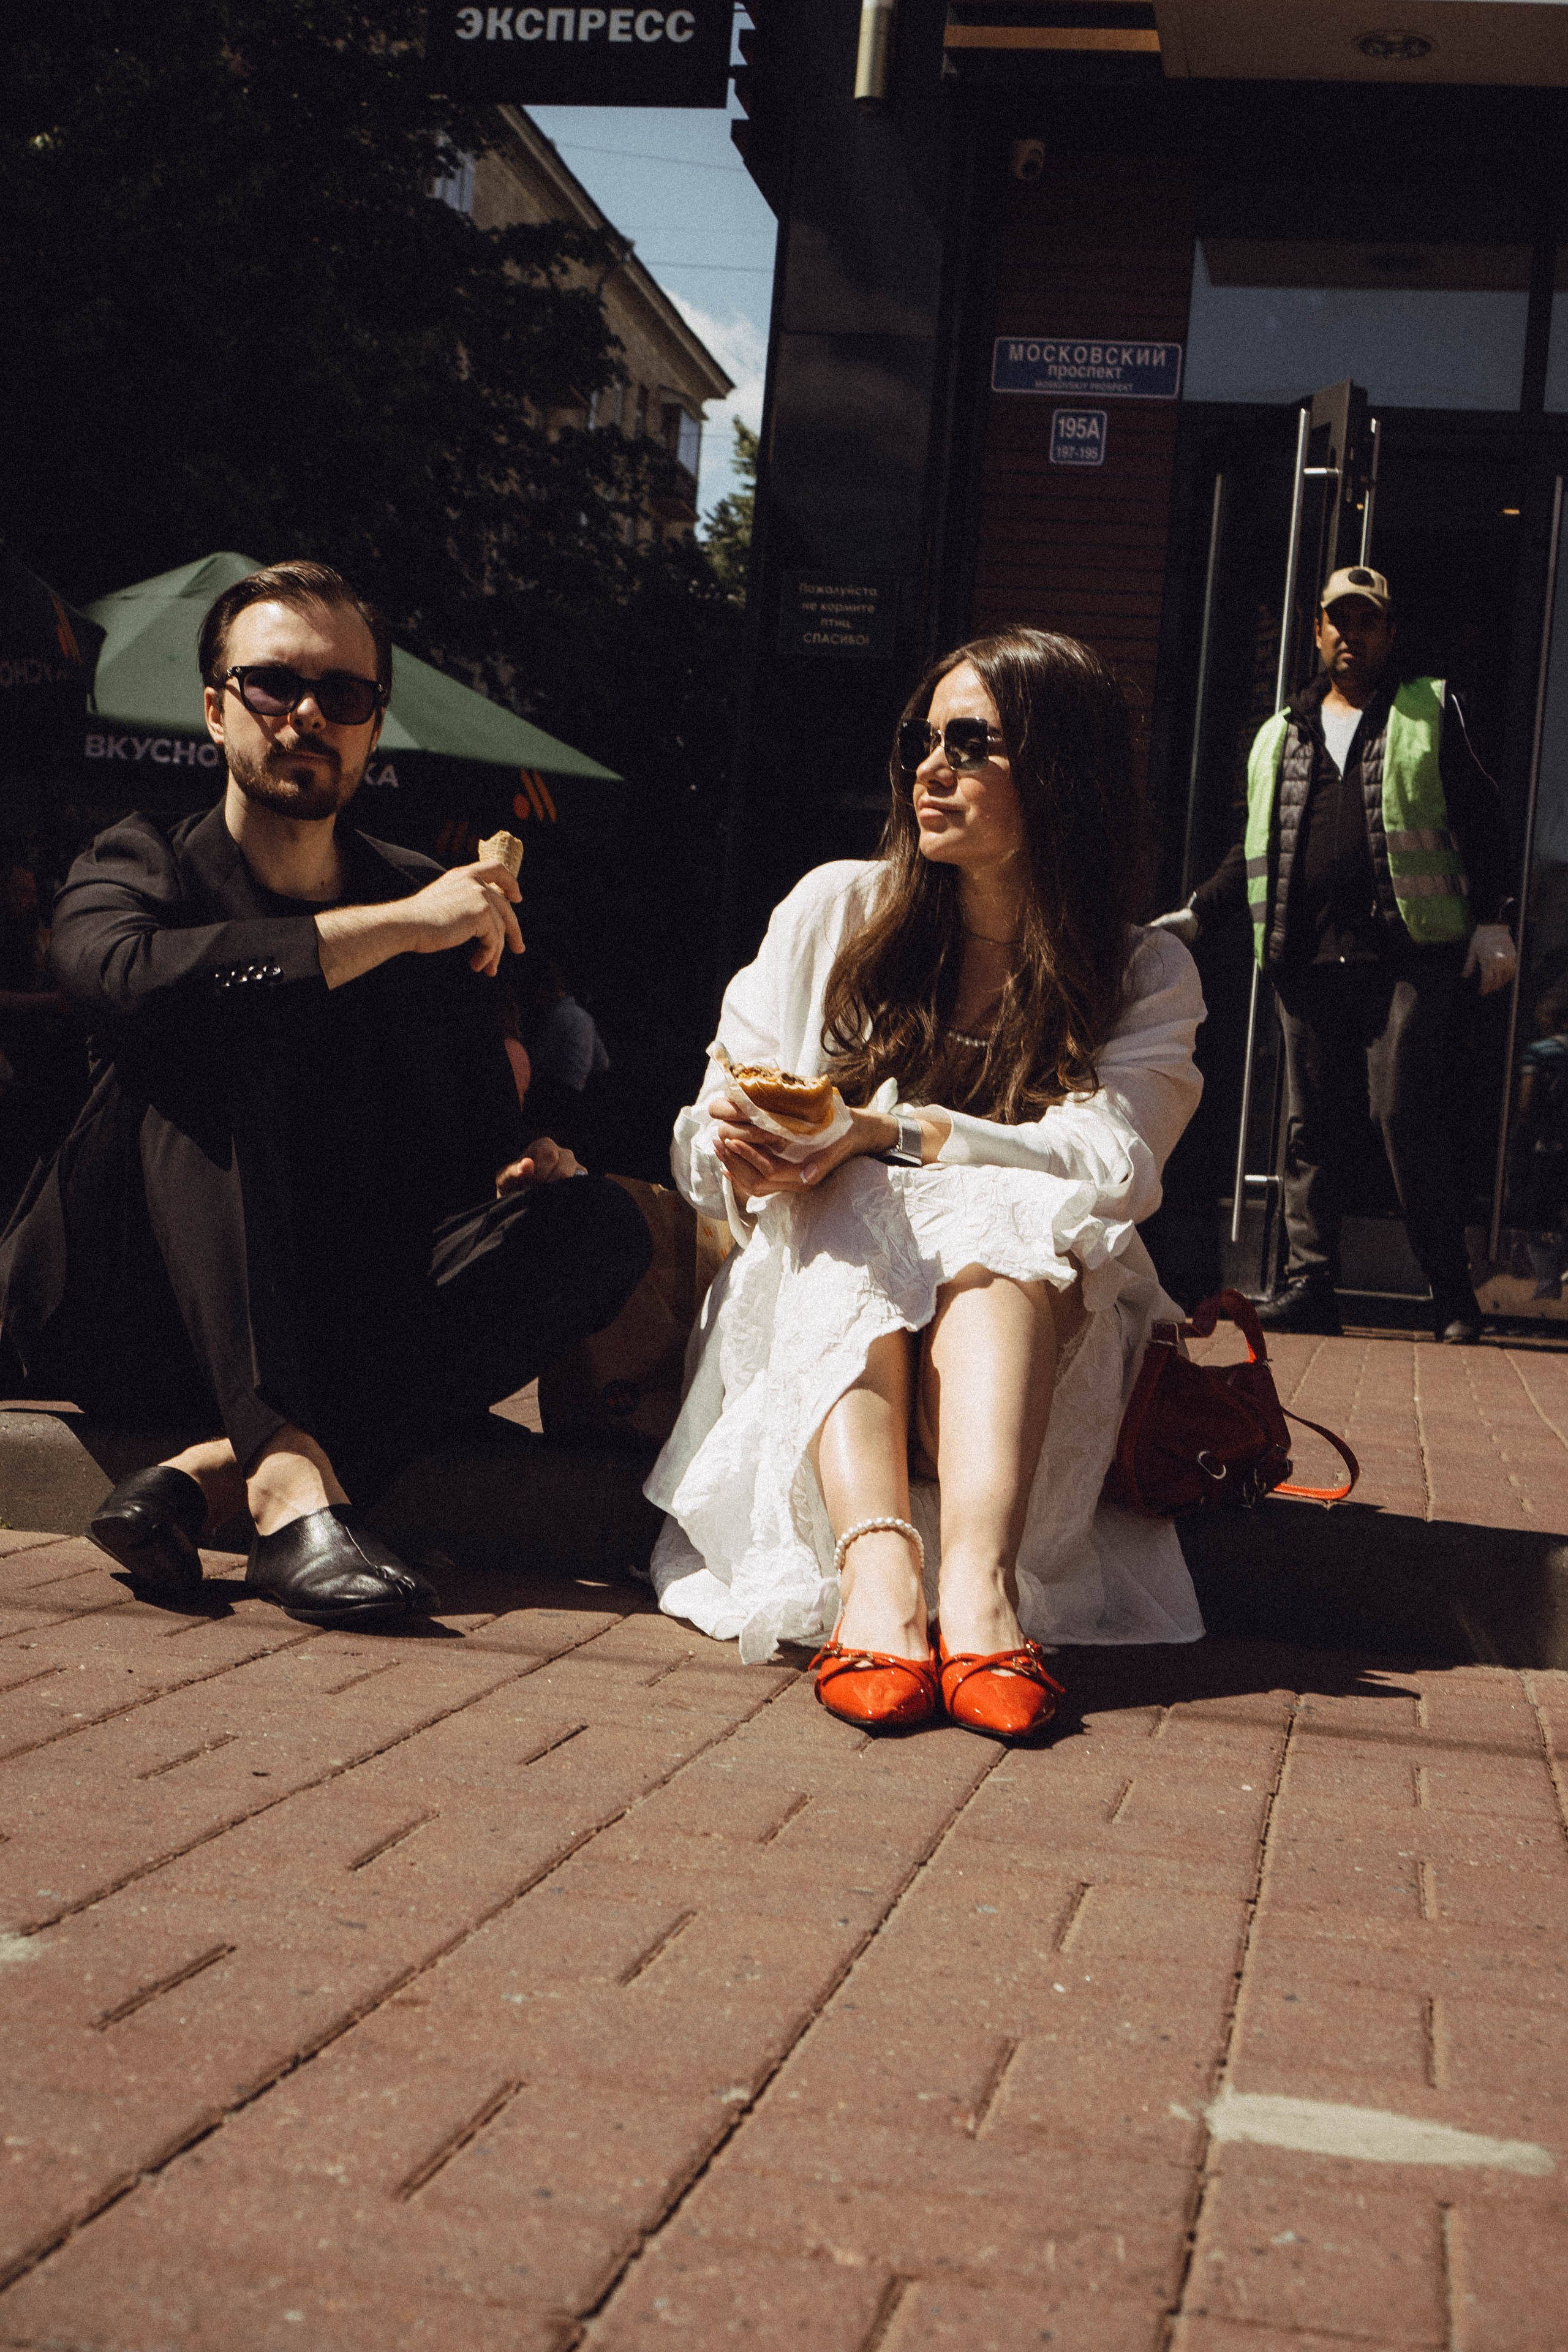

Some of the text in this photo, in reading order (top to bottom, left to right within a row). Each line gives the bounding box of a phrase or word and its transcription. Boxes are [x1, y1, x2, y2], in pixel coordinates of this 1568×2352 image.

[455, 7, 696, 42] ЭКСПРЕСС
[1009, 344, 1166, 366] МОСКОВСКИЙ
[1048, 366, 1123, 380] проспект
[1058, 417, 1101, 439] 195А
[85, 734, 219, 768] ВКУСНО
